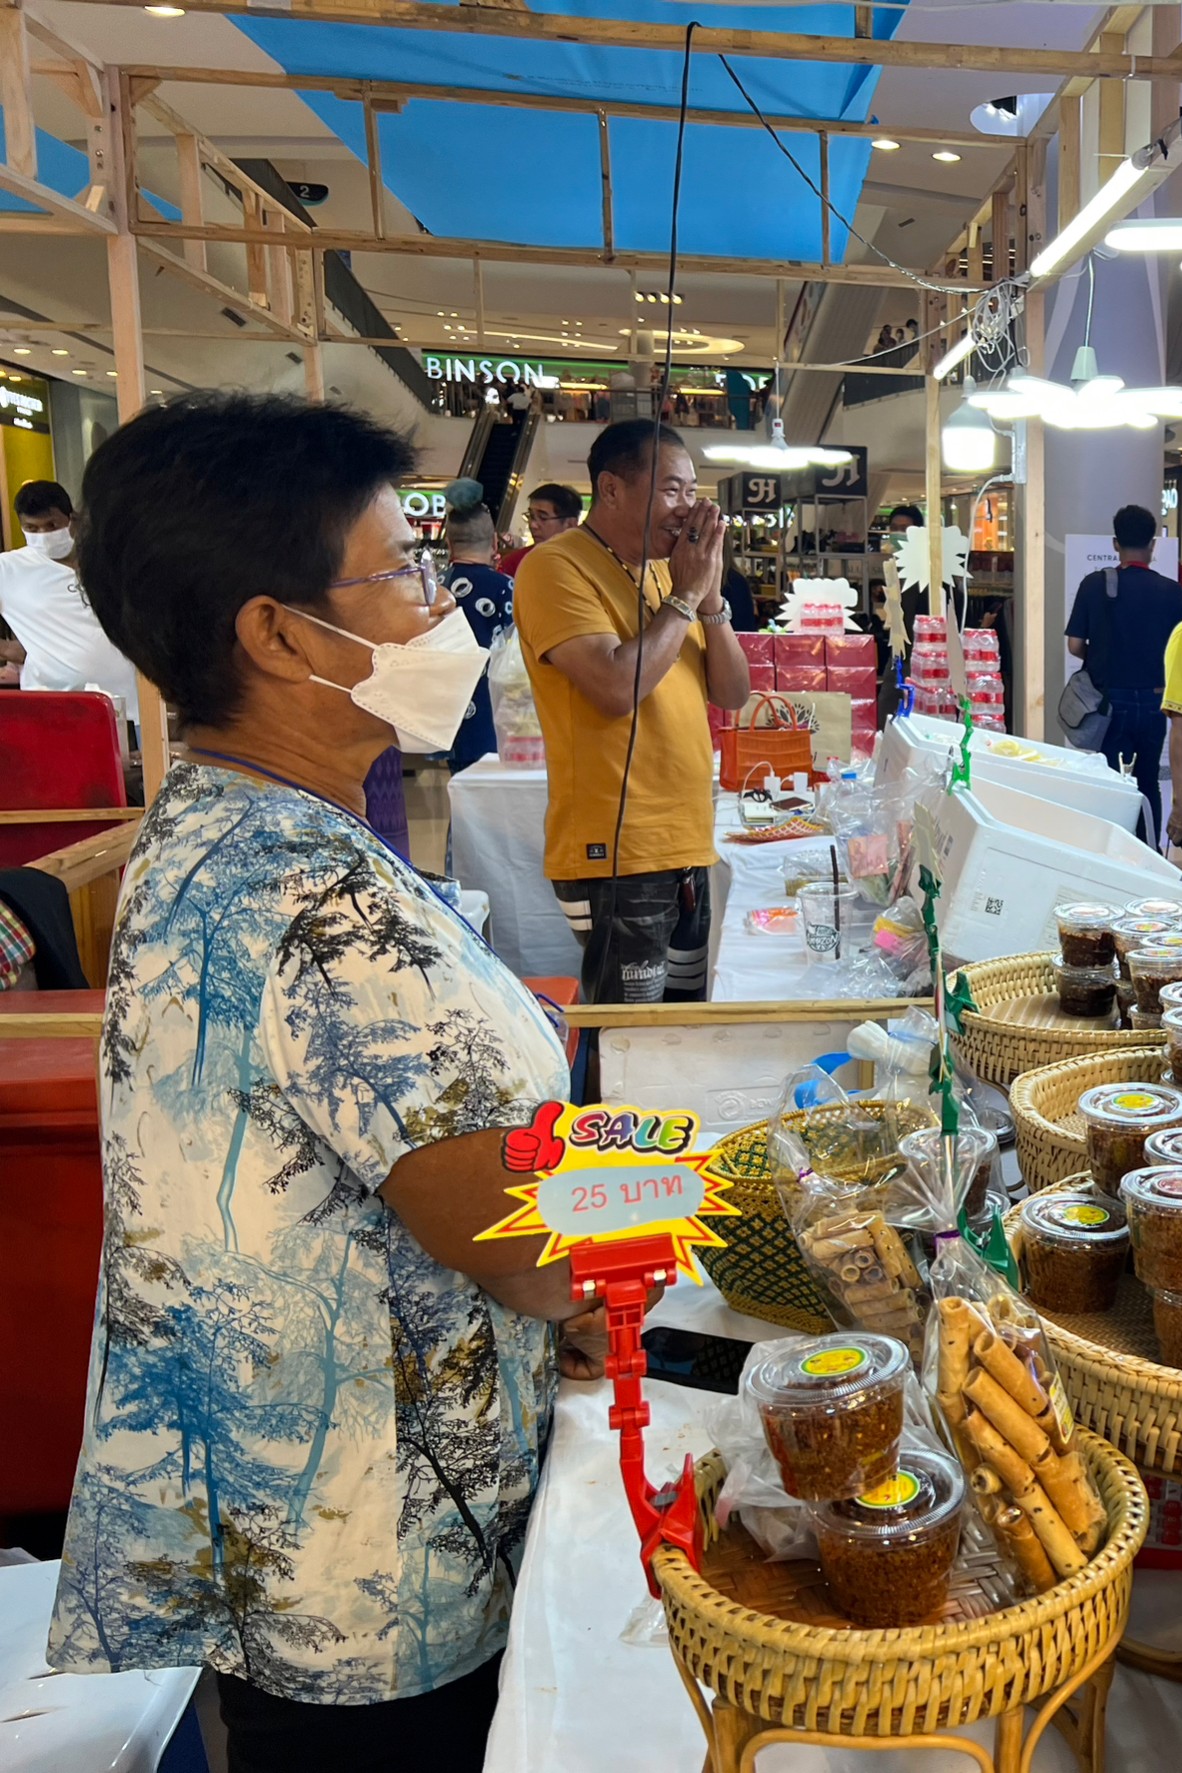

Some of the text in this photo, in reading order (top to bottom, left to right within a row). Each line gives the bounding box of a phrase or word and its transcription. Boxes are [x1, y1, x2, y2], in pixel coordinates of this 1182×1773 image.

[300, 185, 310, 198] 2
[427, 357, 544, 389] BINSON
[569, 1110, 694, 1155] SALE
[571, 1173, 684, 1213] 25 บาท
